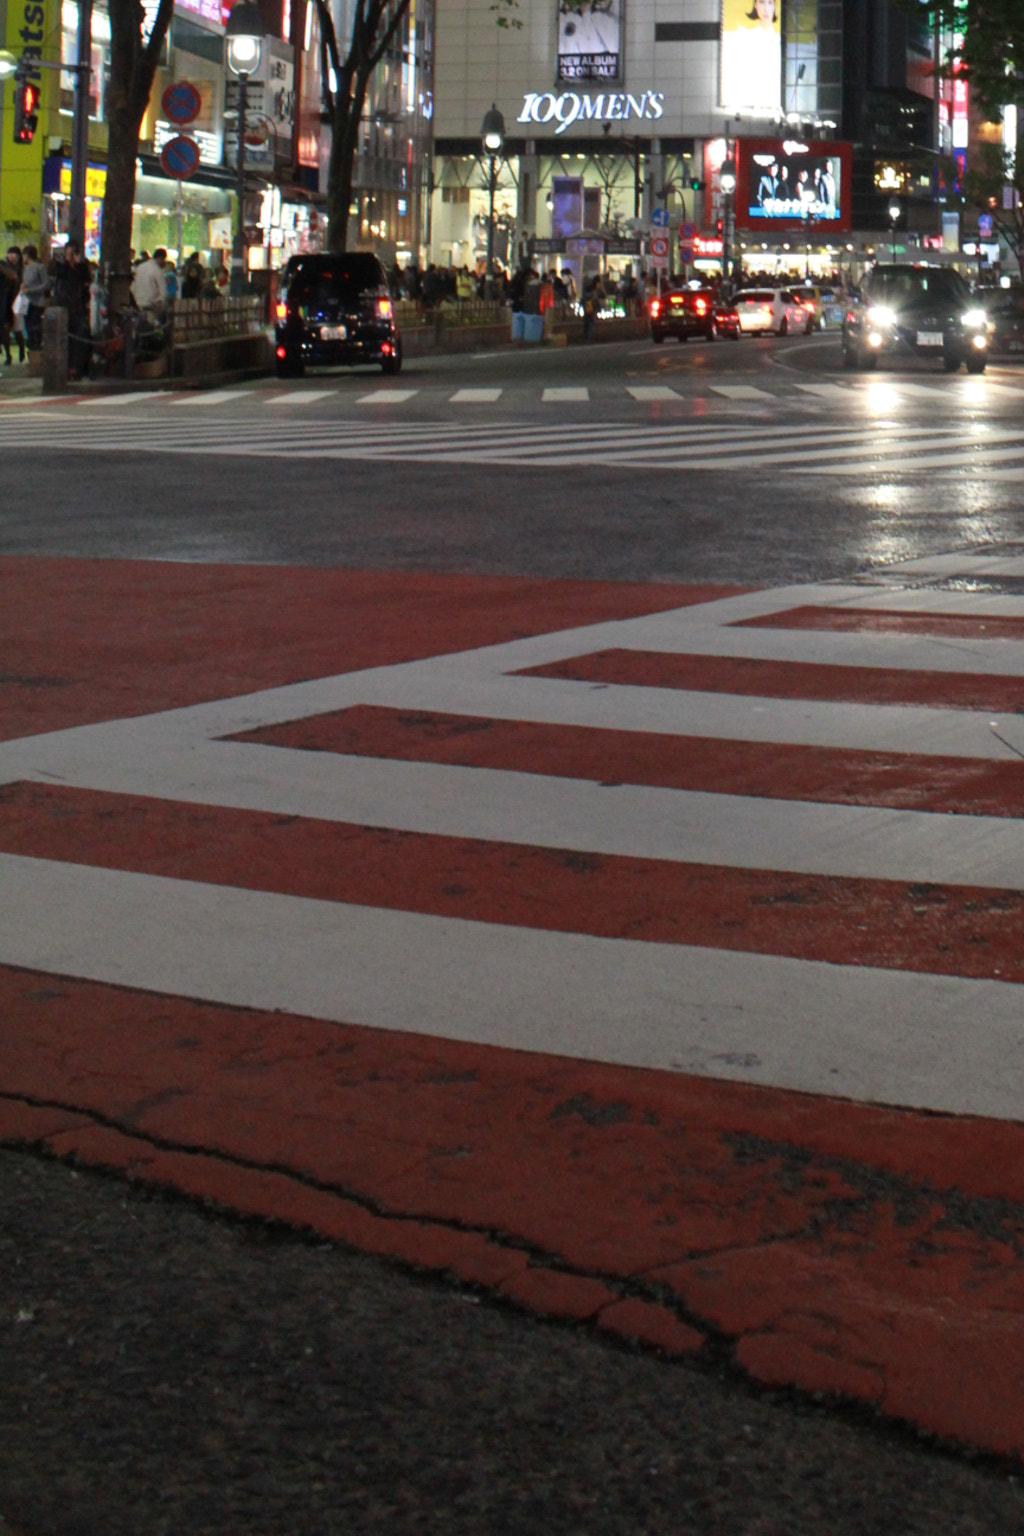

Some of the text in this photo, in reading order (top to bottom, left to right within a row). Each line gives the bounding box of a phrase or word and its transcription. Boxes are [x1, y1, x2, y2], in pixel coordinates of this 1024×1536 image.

[560, 56, 616, 66] NEW ALBUM
[591, 66, 616, 76] SALE
[517, 90, 664, 134] 109MEN'S
